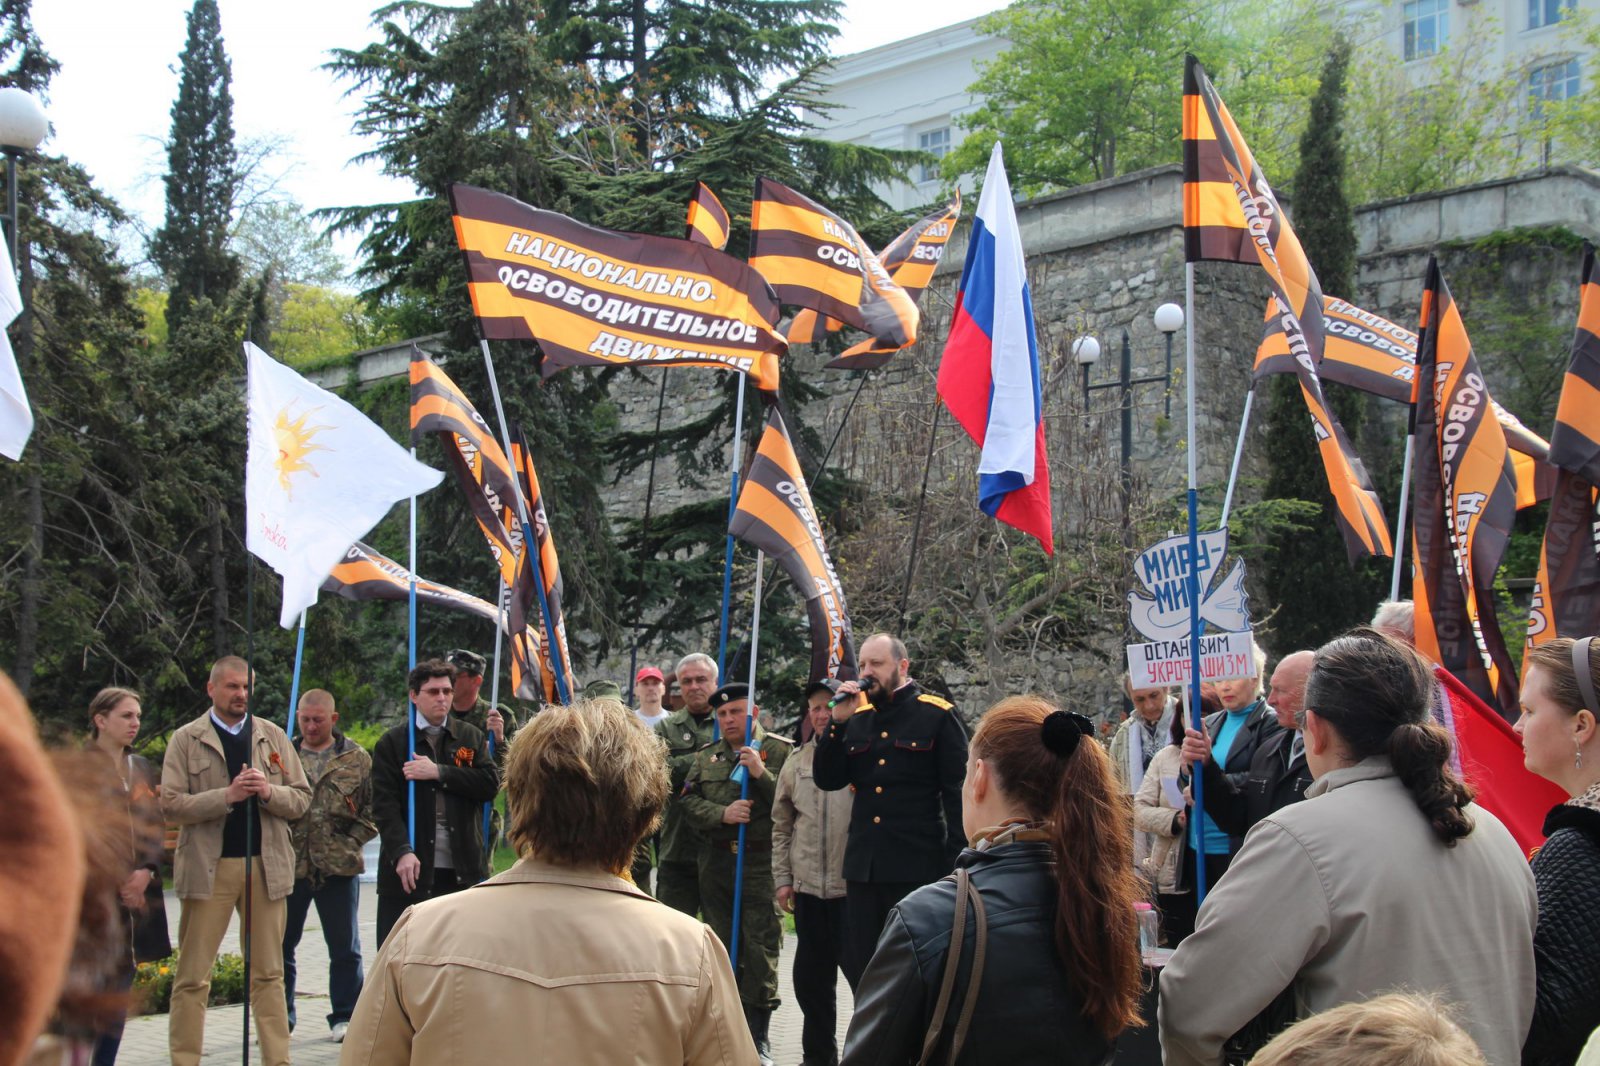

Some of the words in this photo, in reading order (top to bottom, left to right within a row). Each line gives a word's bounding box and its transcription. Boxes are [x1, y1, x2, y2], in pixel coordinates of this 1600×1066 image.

[505, 232, 717, 301] НАЦИОНАЛЬНО-
[498, 266, 757, 343] ОСВОБОДИТЕЛЬНОЕ
[1144, 636, 1229, 661] ОСТАНВИМ
